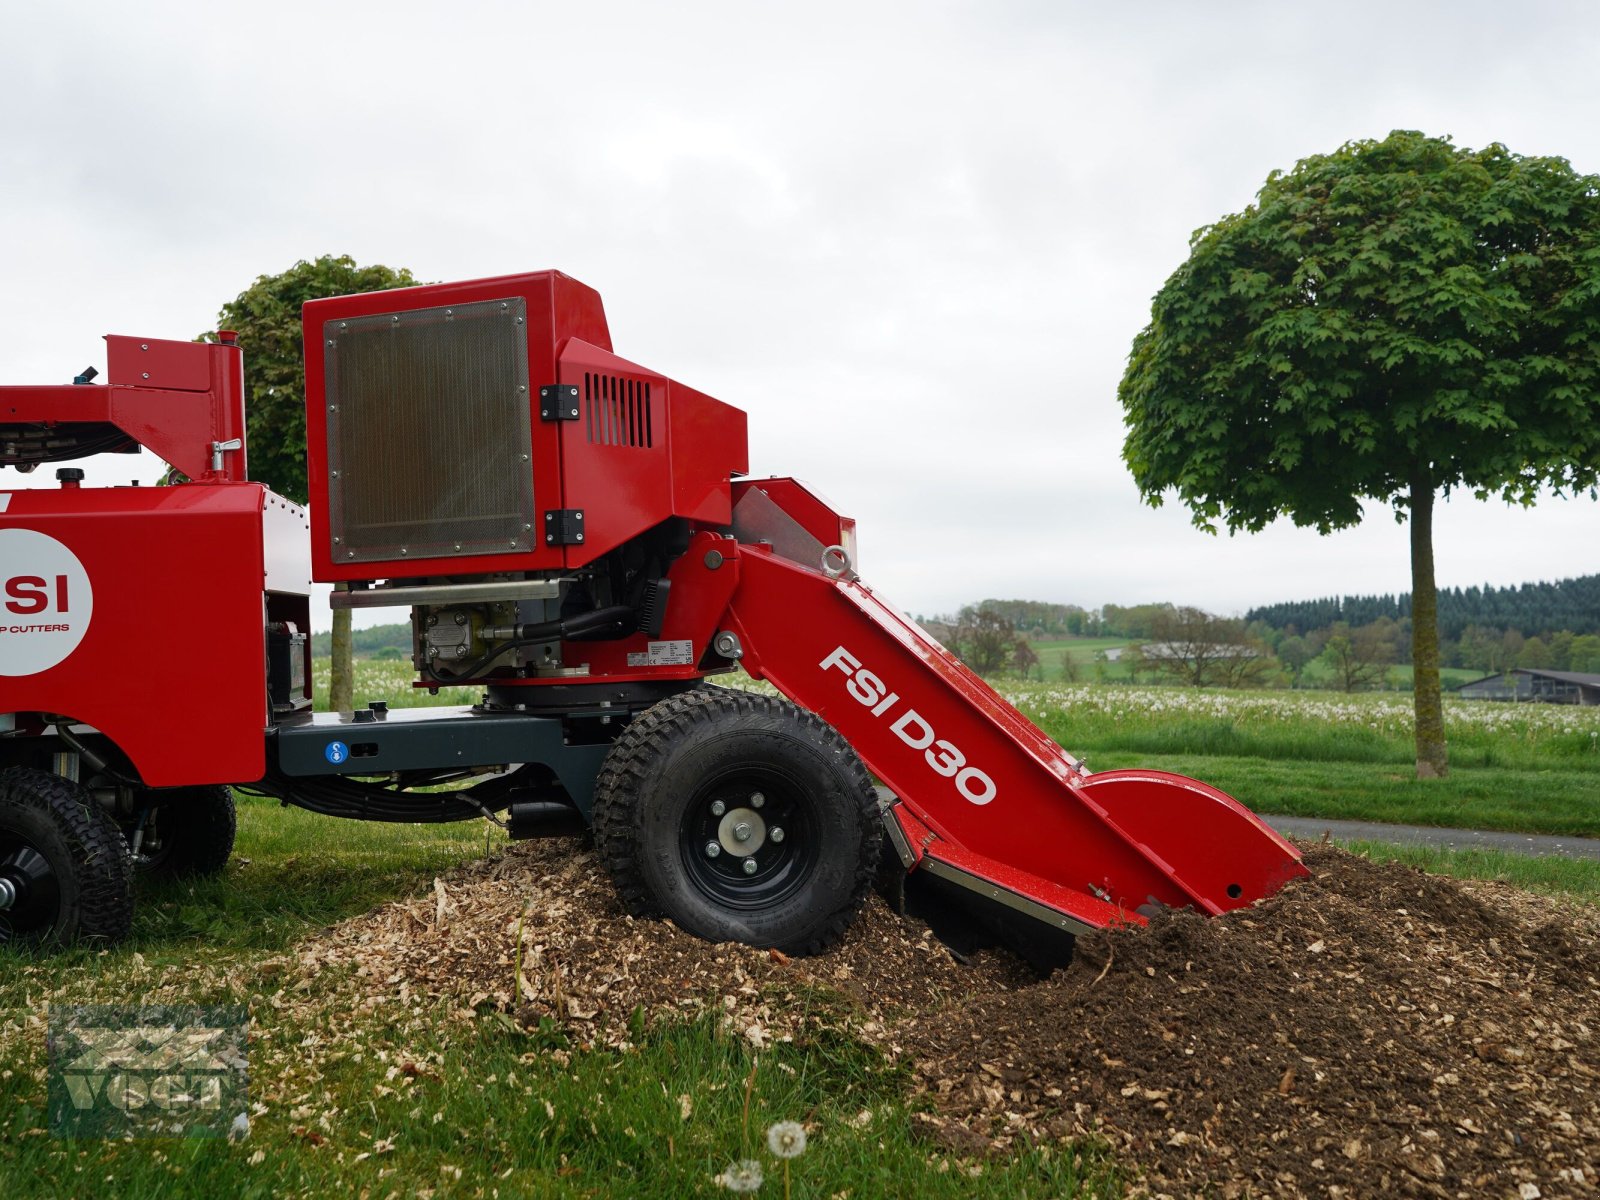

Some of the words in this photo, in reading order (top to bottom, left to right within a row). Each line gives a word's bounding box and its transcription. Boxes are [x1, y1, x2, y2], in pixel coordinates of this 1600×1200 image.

[10, 624, 70, 633] CUTTERS
[818, 645, 900, 718] FSI
[889, 708, 997, 806] D30
